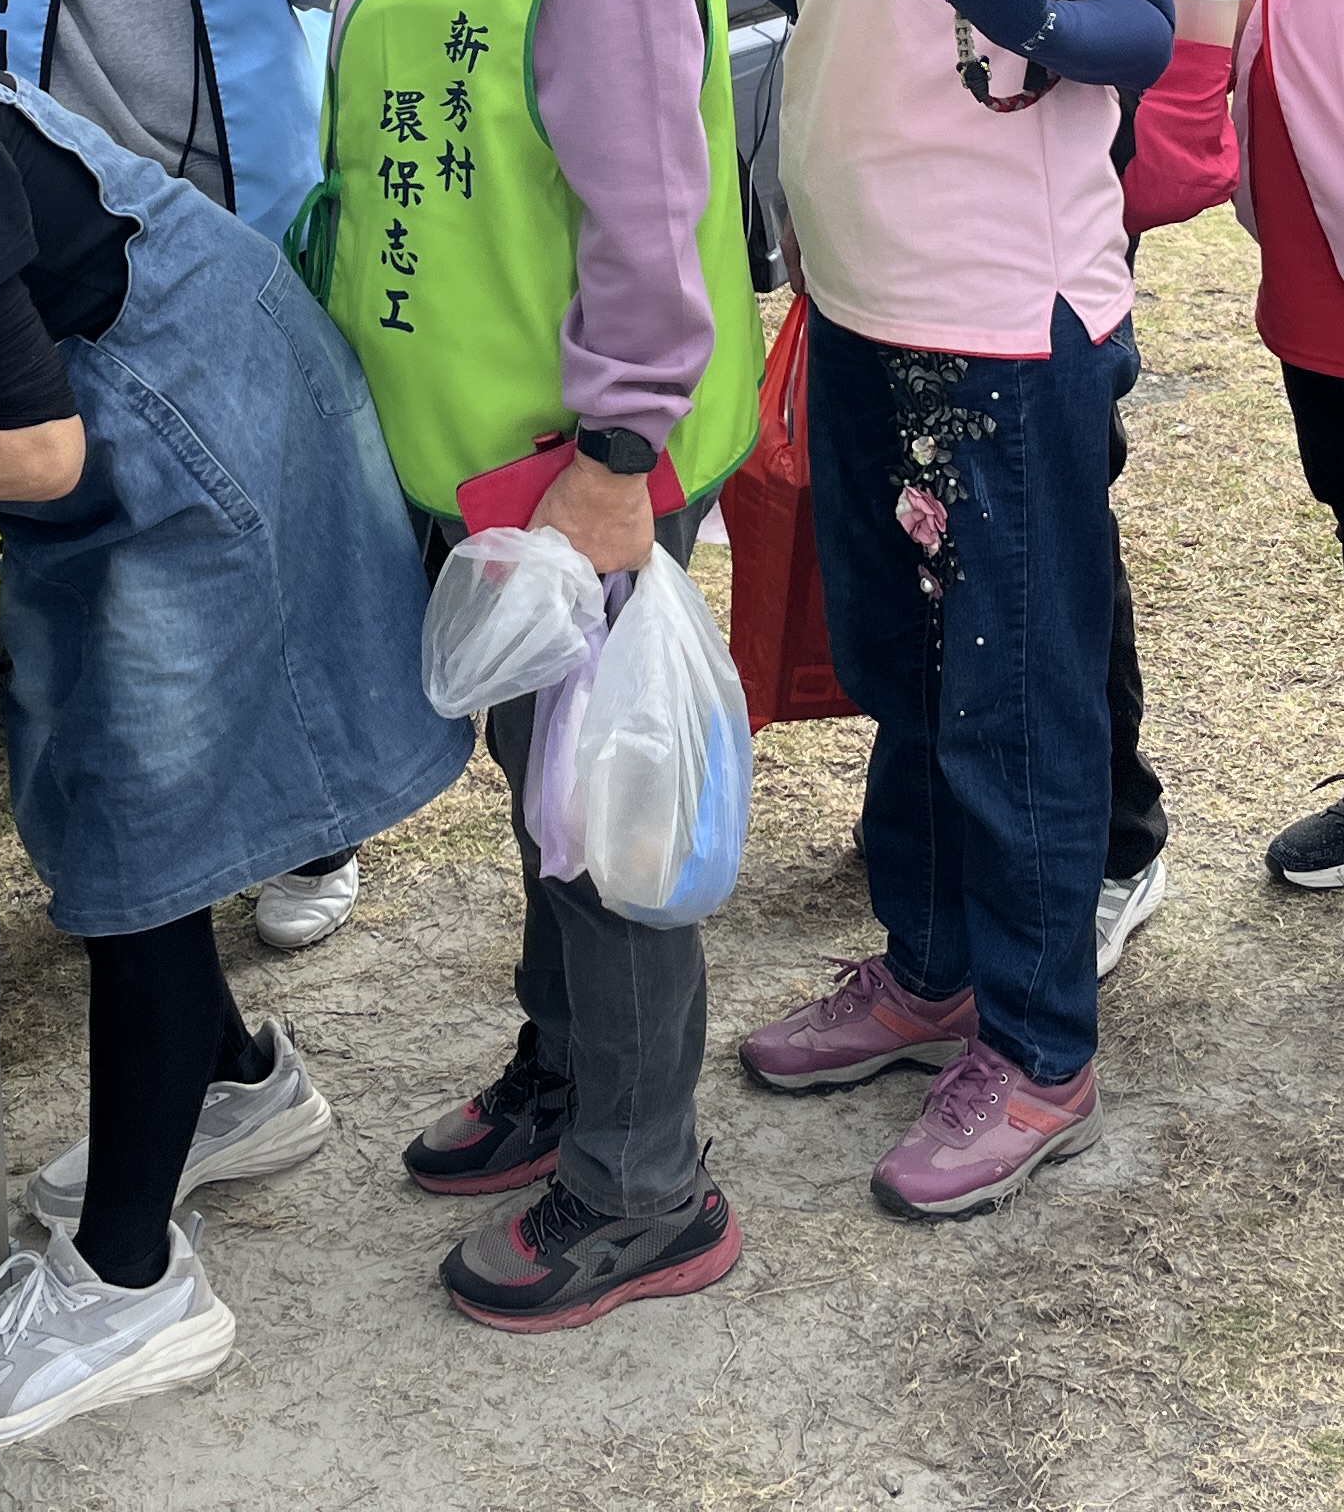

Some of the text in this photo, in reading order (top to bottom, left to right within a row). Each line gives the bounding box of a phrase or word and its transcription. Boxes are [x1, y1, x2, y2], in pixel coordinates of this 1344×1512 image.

[378, 89, 429, 333] 環保志工
[436, 11, 490, 199] 新秀村
